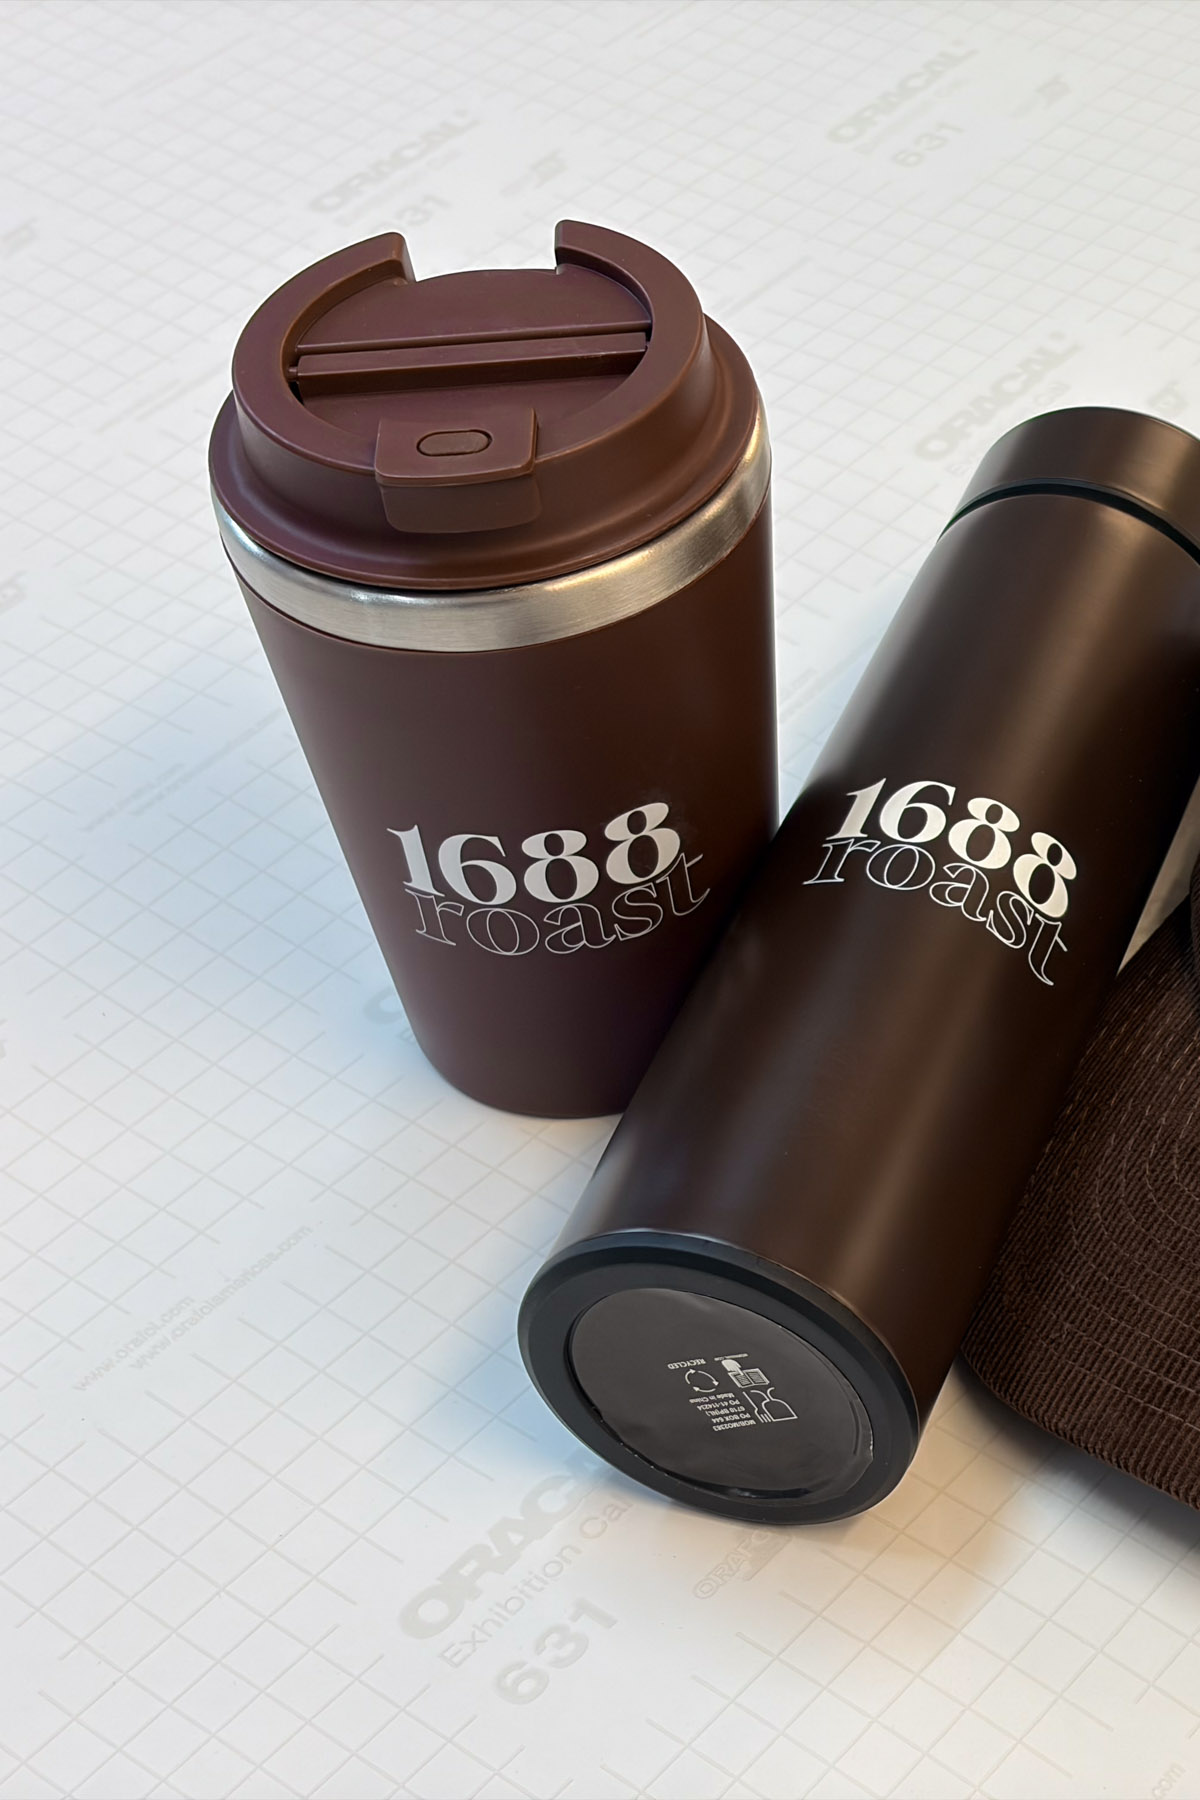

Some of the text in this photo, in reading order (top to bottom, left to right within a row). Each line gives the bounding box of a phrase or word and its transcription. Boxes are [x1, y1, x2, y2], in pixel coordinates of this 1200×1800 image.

[826, 47, 981, 144] ORACAL
[890, 121, 965, 168] 631
[914, 342, 1085, 462] ORACAL
[386, 802, 681, 905] 1688
[825, 777, 1078, 919] 1688
[404, 852, 711, 956] roast
[802, 838, 1069, 986] roast
[666, 1358, 707, 1370] RECYCLED
[689, 1396, 709, 1404] China
[437, 1543, 583, 1669] Exhibition
[492, 1596, 619, 1706] 631
